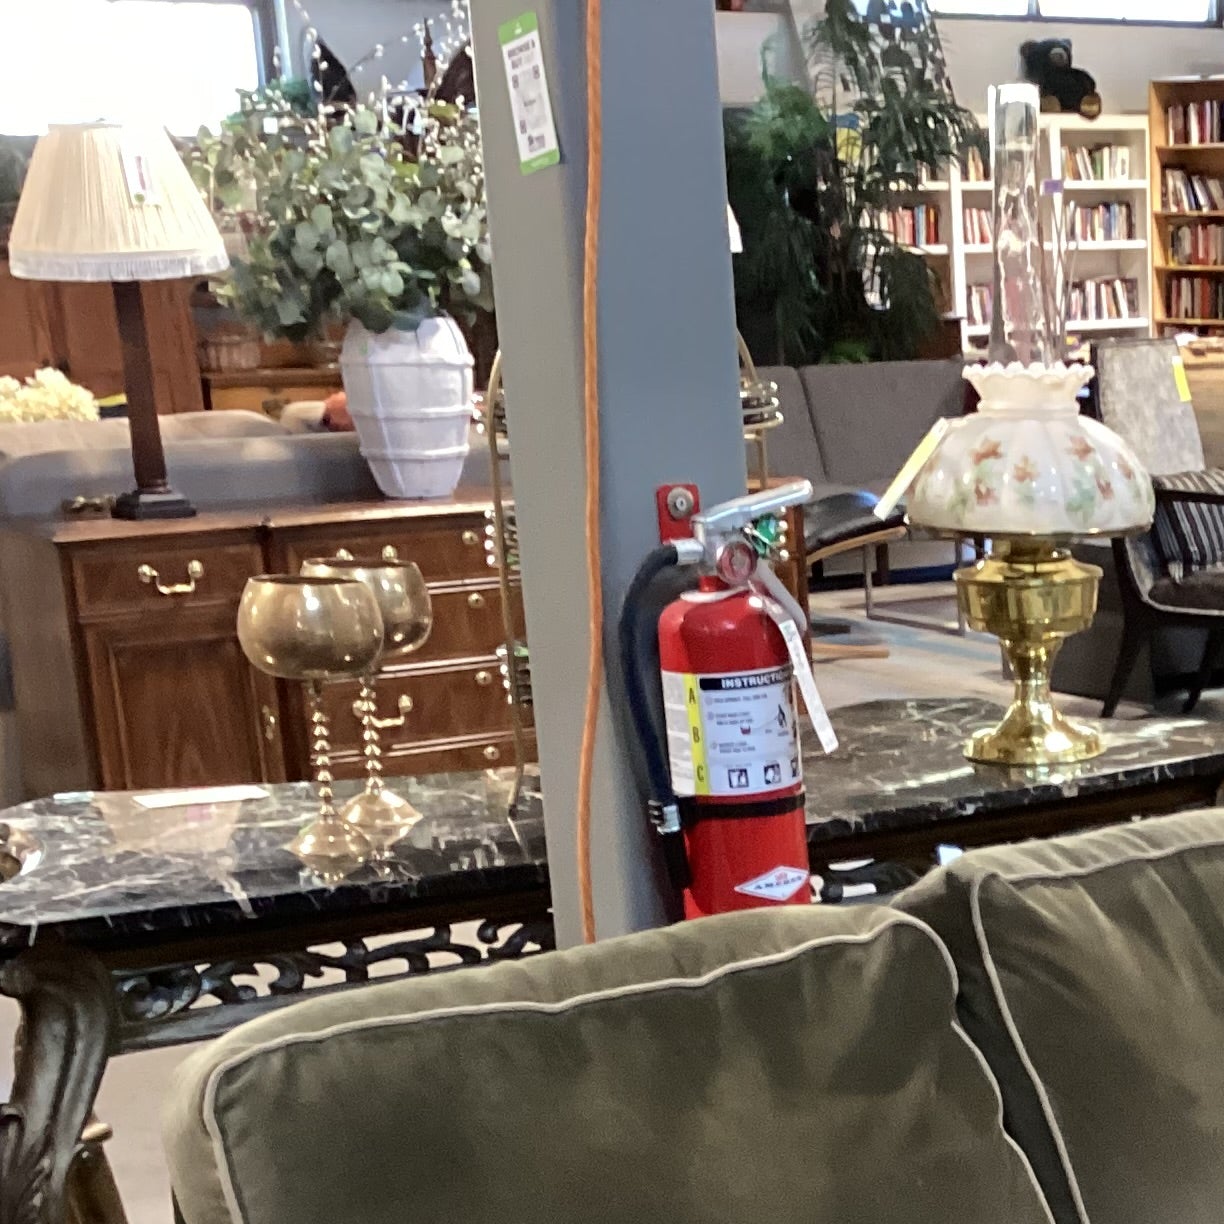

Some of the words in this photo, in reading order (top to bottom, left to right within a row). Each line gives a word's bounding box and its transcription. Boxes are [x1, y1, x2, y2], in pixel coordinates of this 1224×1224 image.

[689, 687, 696, 705] A
[692, 726, 700, 743] B
[697, 765, 704, 782] C
